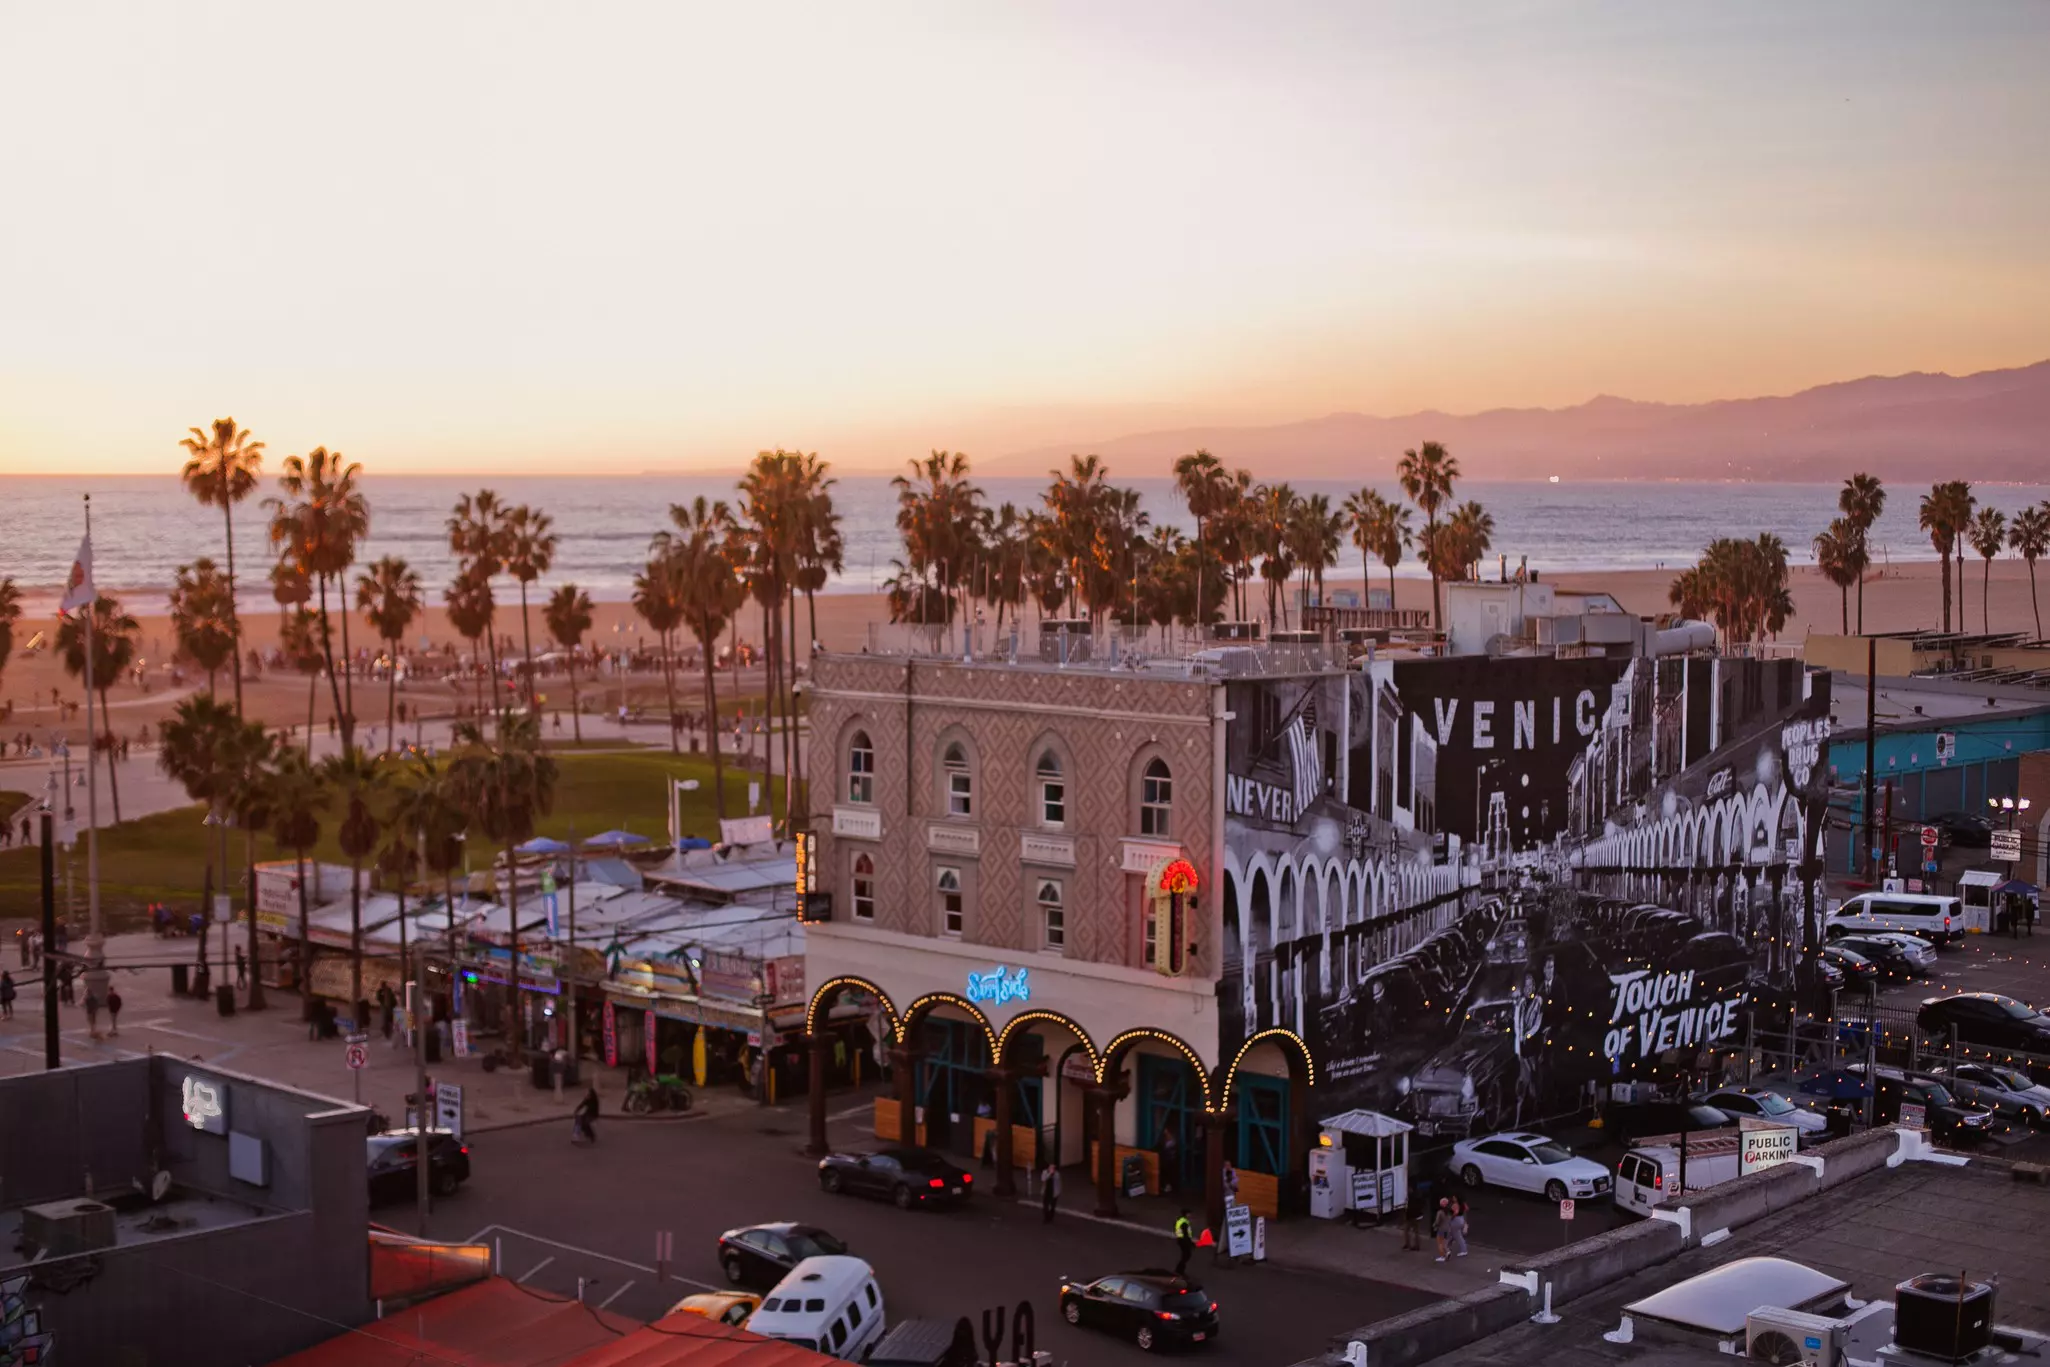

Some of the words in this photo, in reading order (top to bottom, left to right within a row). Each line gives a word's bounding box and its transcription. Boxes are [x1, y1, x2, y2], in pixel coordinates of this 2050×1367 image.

[1434, 683, 1632, 750] VENICE
[1789, 744, 1819, 769] DRUG
[1226, 773, 1292, 822] NEVER
[808, 835, 816, 892] BAR
[1604, 1026, 1635, 1059] OF
[1748, 1136, 1791, 1149] PUBLIC
